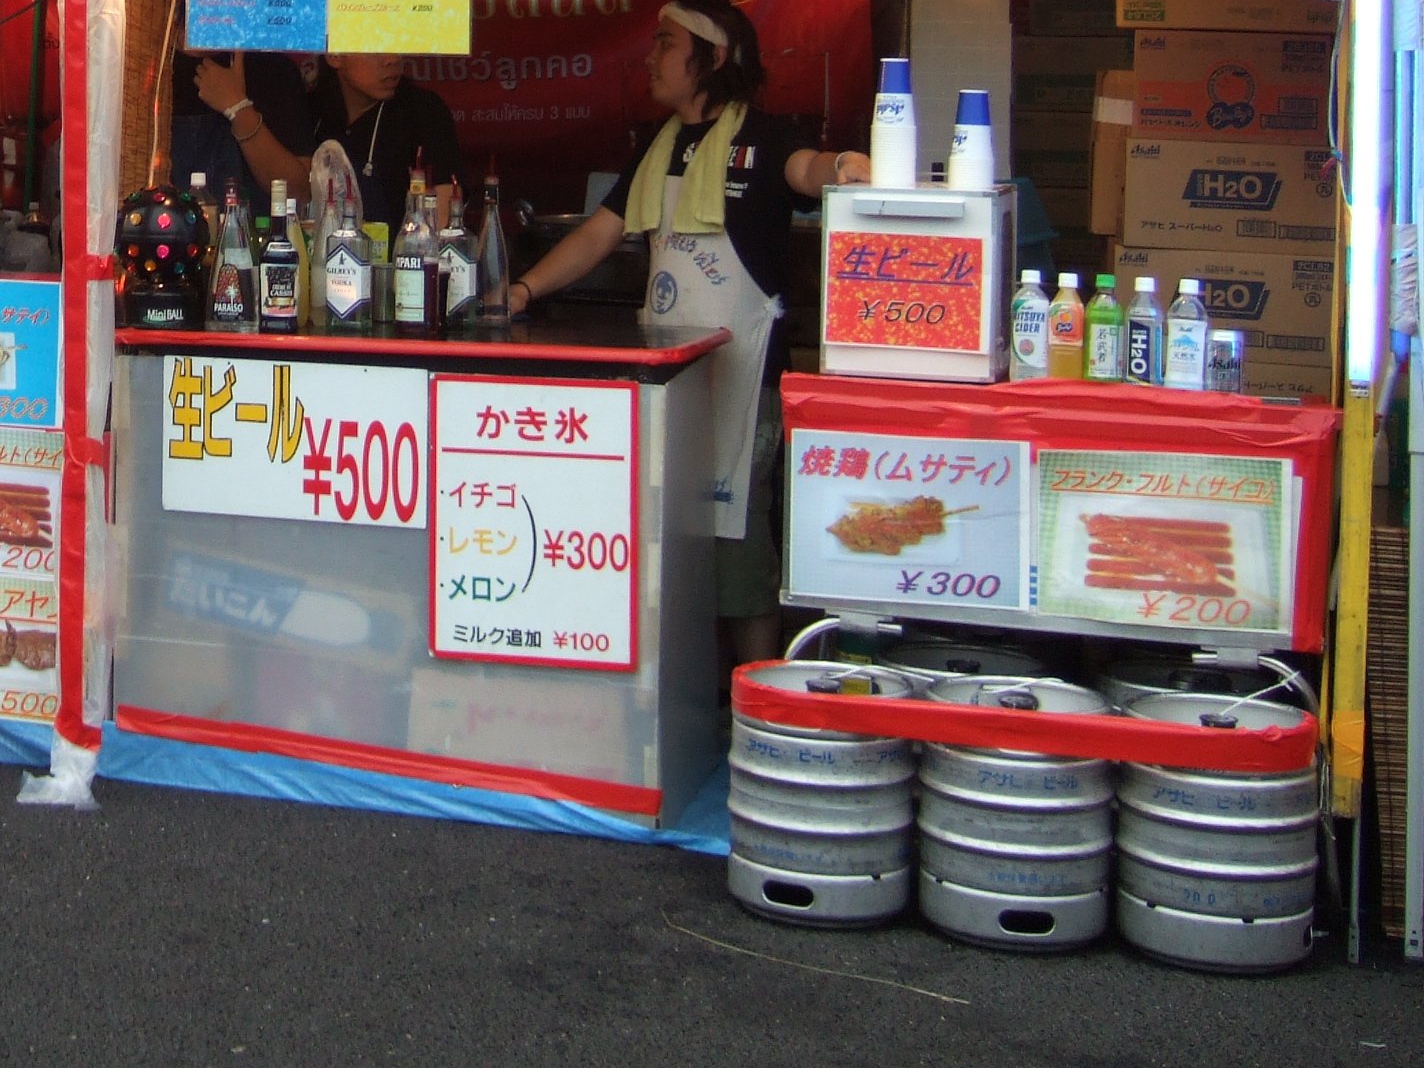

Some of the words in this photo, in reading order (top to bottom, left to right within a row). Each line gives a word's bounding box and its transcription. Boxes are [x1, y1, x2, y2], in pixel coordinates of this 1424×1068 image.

[843, 245, 974, 281] 生ビール
[857, 300, 946, 325] ¥500
[169, 356, 305, 463] 生ビール
[303, 416, 419, 523] ¥500
[476, 405, 590, 444] かき氷
[543, 529, 629, 572] ¥300
[896, 569, 1002, 600] ¥300
[1137, 591, 1252, 627] ¥200
[453, 624, 542, 649] ミルク追加
[553, 630, 610, 653] ¥100
[798, 747, 836, 765] ビール
[1043, 775, 1078, 790] ビール
